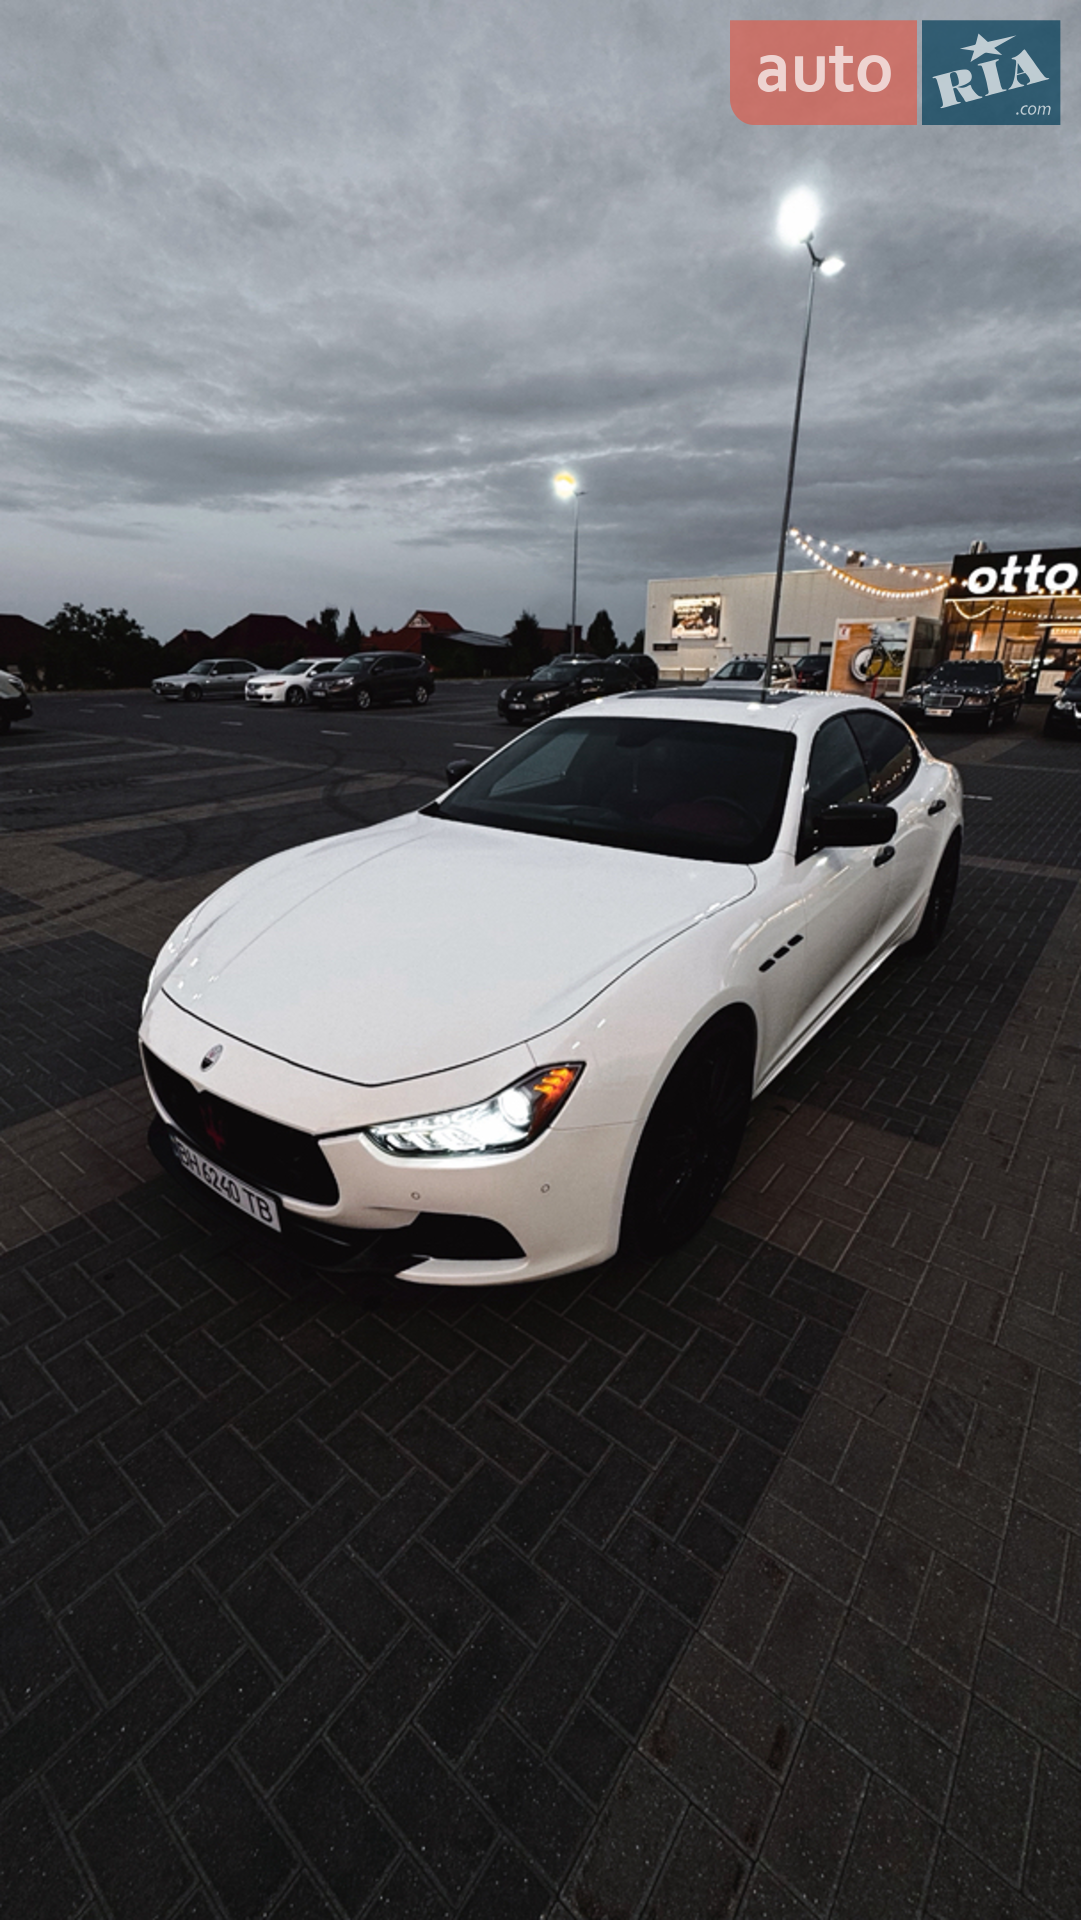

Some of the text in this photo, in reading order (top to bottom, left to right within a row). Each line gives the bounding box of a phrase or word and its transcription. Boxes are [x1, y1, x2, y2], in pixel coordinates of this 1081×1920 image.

[967, 554, 1079, 595] otto
[202, 1162, 240, 1203] 6240
[241, 1187, 273, 1223] TB
